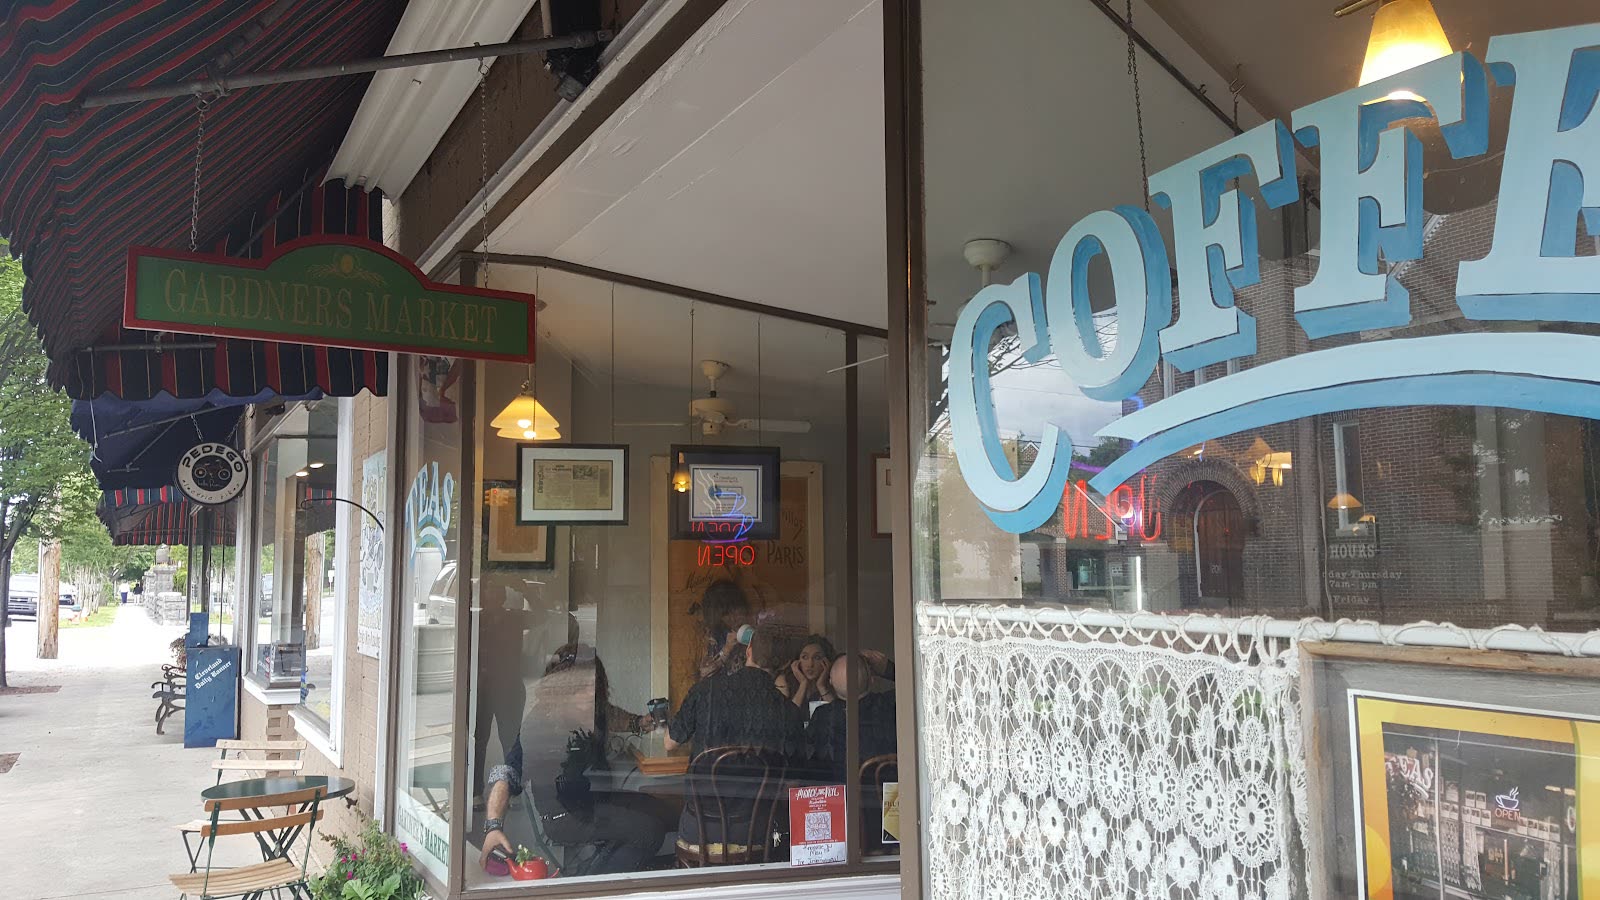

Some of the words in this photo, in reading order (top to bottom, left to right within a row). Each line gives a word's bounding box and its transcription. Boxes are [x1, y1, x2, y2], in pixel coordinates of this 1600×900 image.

[165, 268, 353, 329] GARDNERS
[366, 291, 498, 343] MARKET
[182, 445, 243, 473] PEDEGO
[406, 461, 454, 552] TEAS
[767, 540, 805, 569] PARIS
[1329, 544, 1376, 559] HOURS
[194, 658, 223, 680] Cleveland
[194, 676, 213, 690] Daily
[210, 660, 232, 678] Banner
[1495, 807, 1520, 821] OPEN
